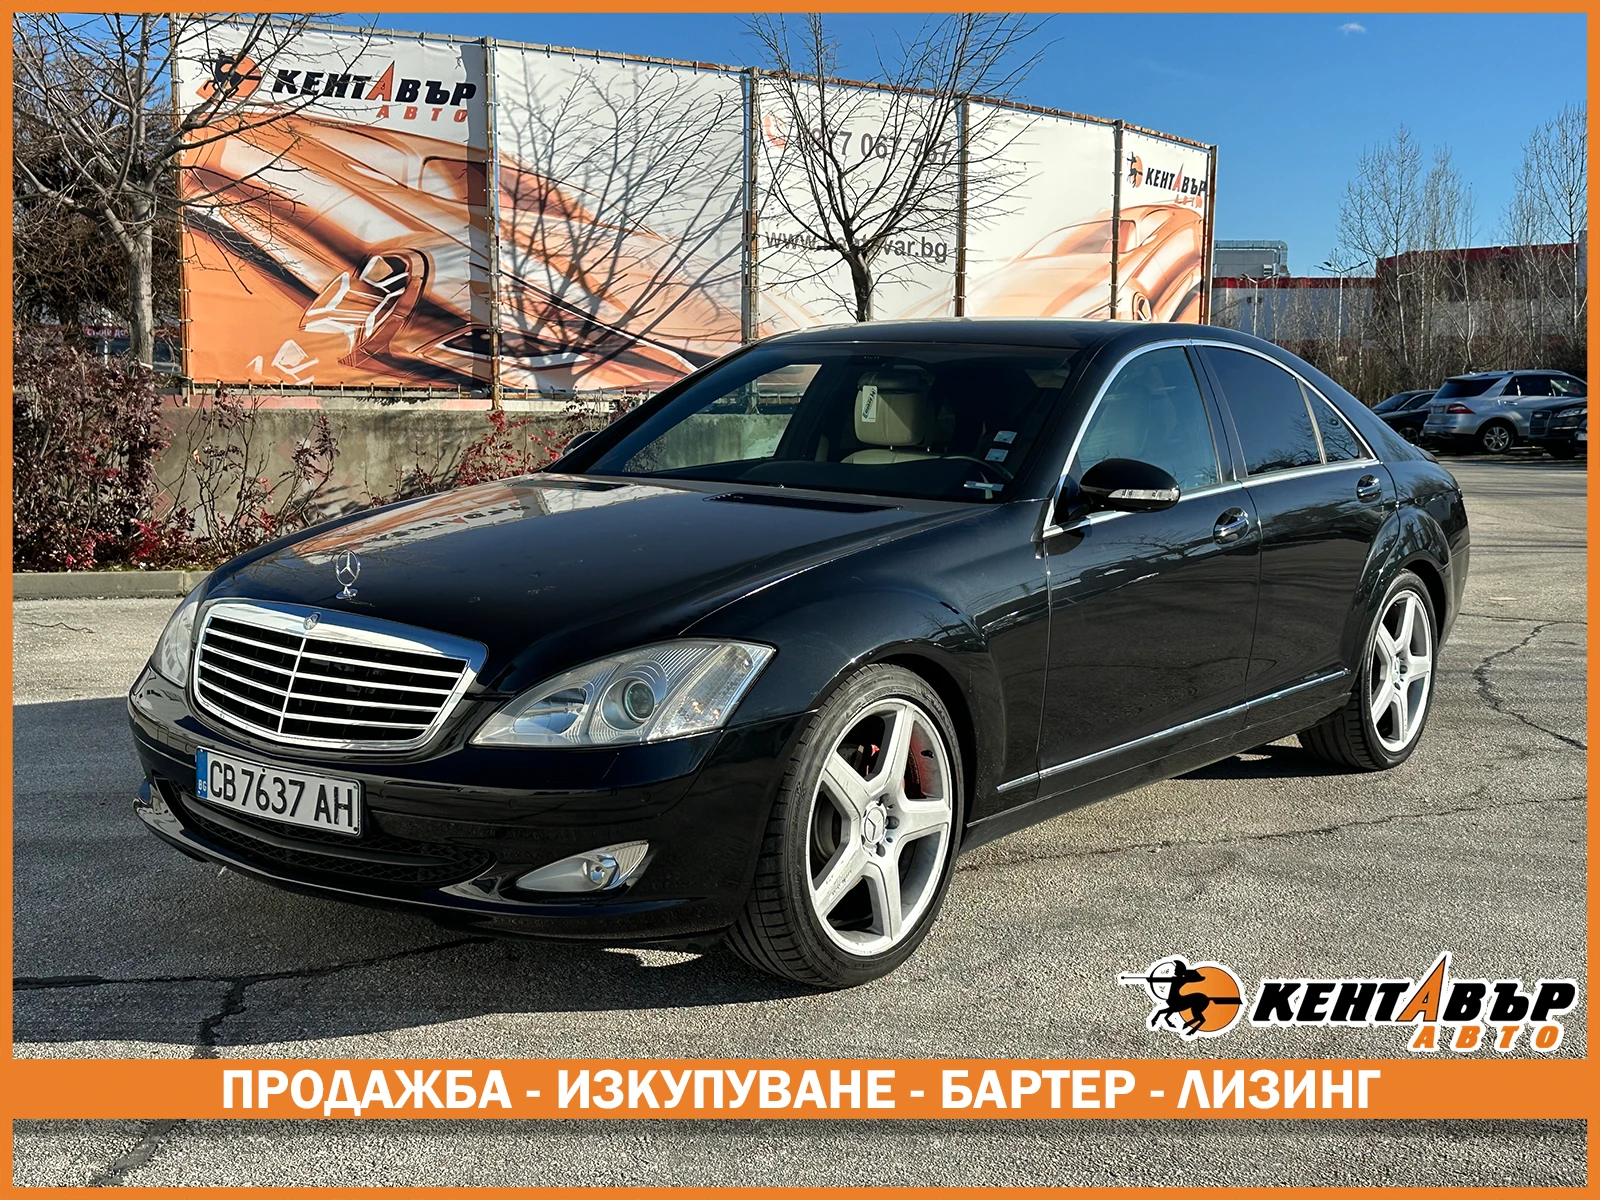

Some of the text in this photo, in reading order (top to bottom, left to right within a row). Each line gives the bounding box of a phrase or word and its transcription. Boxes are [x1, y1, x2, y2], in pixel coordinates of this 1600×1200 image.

[272, 60, 477, 106] КЕНТАВЪР
[376, 104, 469, 123] АВТО
[1145, 163, 1207, 196] КЕНТАВЪР
[198, 780, 207, 792] BG
[314, 784, 353, 828] AH
